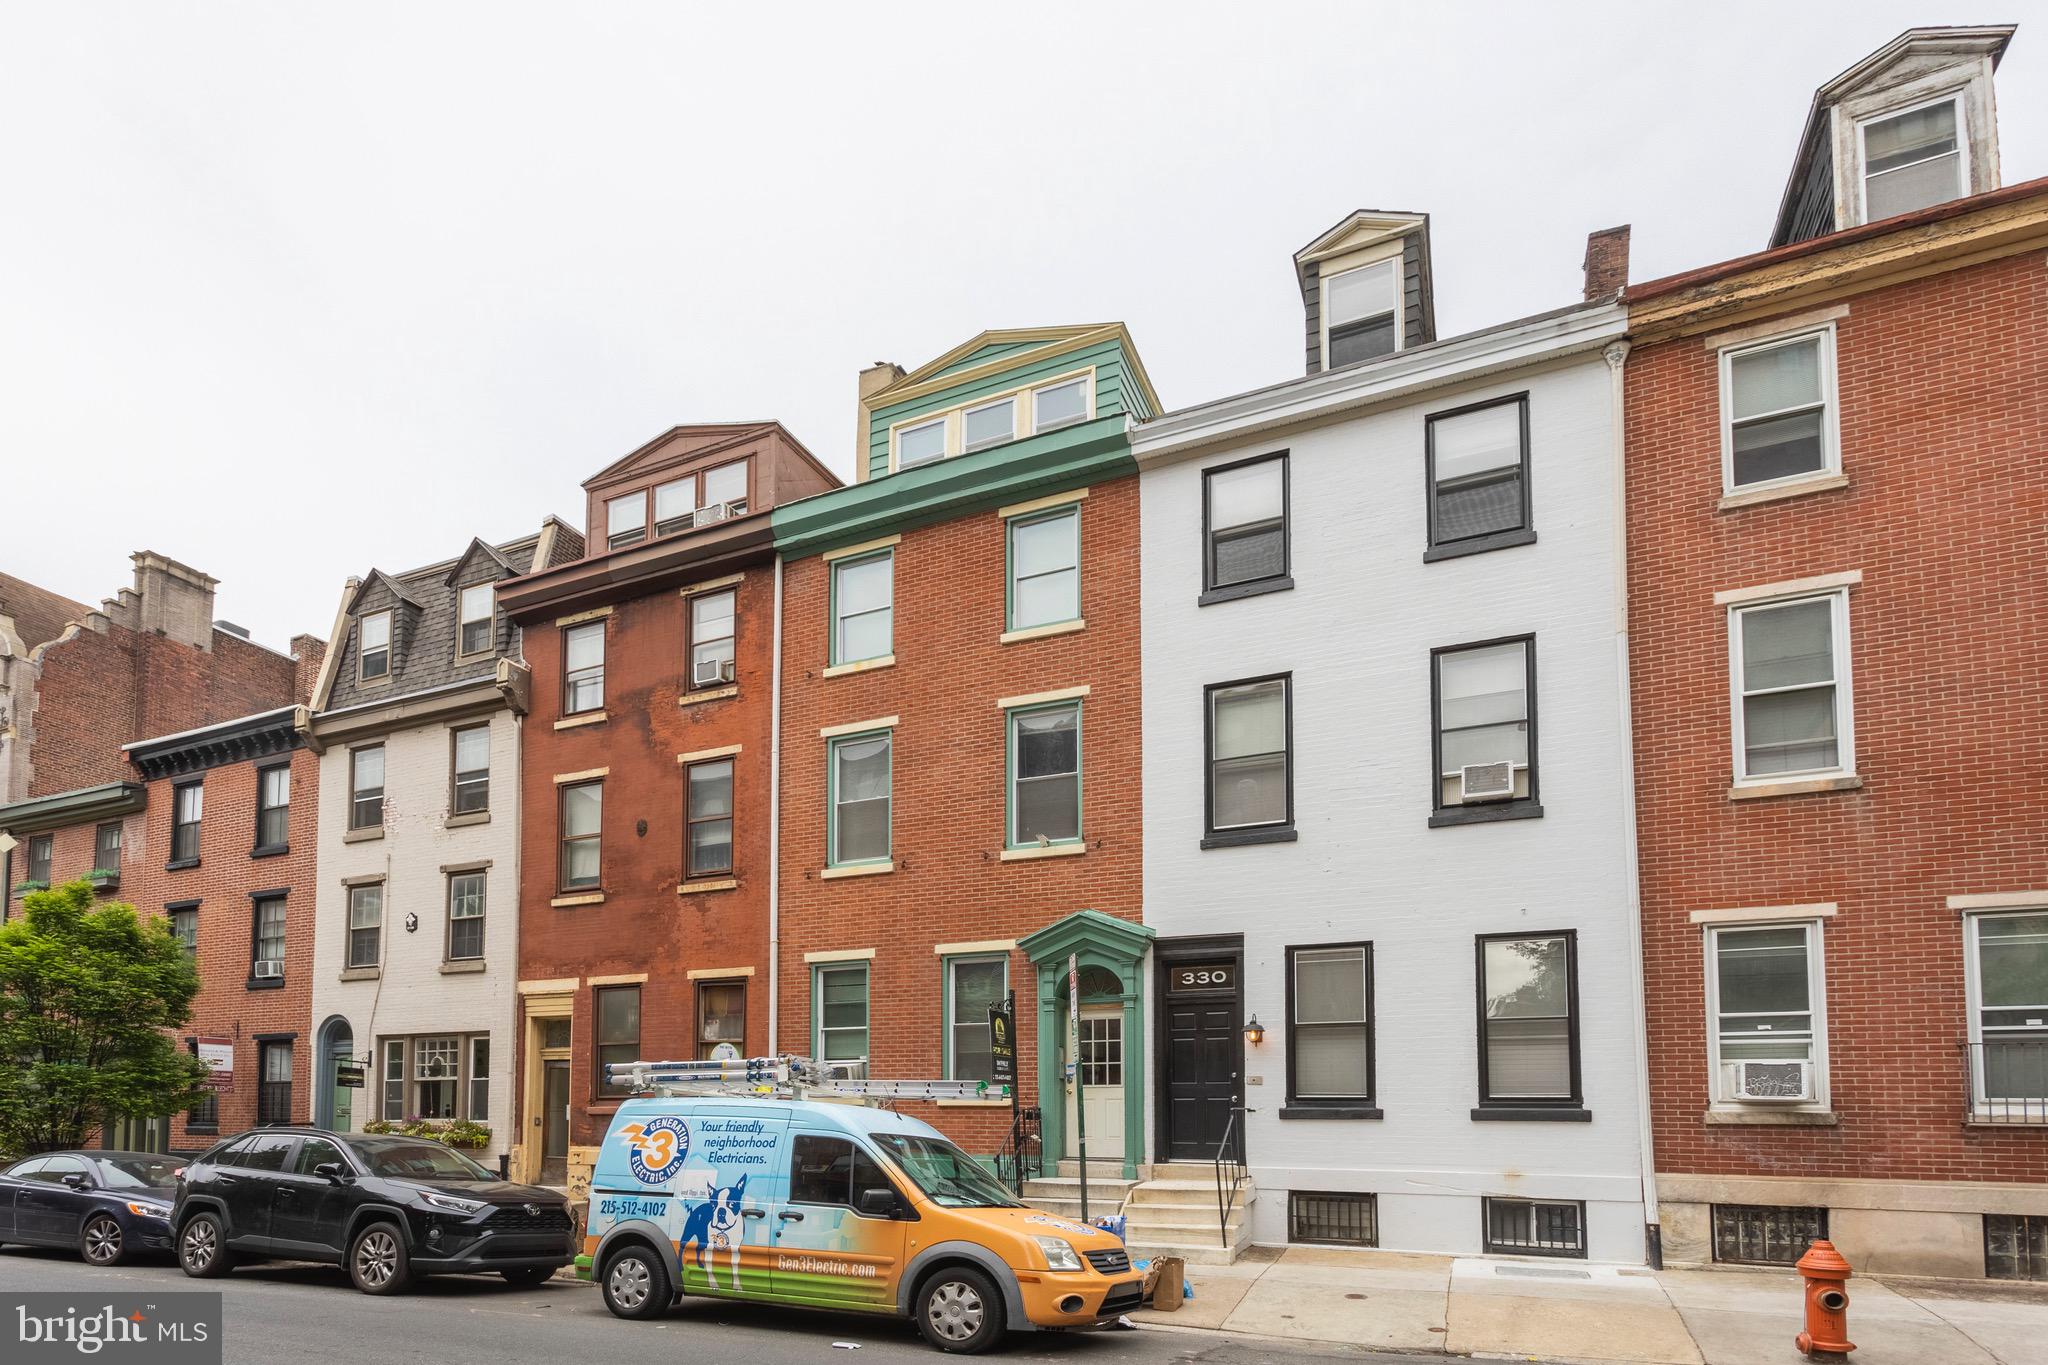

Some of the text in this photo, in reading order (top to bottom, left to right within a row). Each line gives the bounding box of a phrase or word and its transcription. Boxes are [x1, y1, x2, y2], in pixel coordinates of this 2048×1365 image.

[1182, 971, 1226, 984] 330
[649, 1118, 688, 1150] GENERATION
[701, 1120, 765, 1136] Your friendly
[645, 1131, 673, 1169] 3
[704, 1136, 778, 1150] neighborhood
[708, 1151, 767, 1164] Electricians.
[667, 1159, 682, 1176] Inc.
[600, 1200, 666, 1217] 215-512-4102
[778, 1254, 876, 1278] Gen3Electric.com
